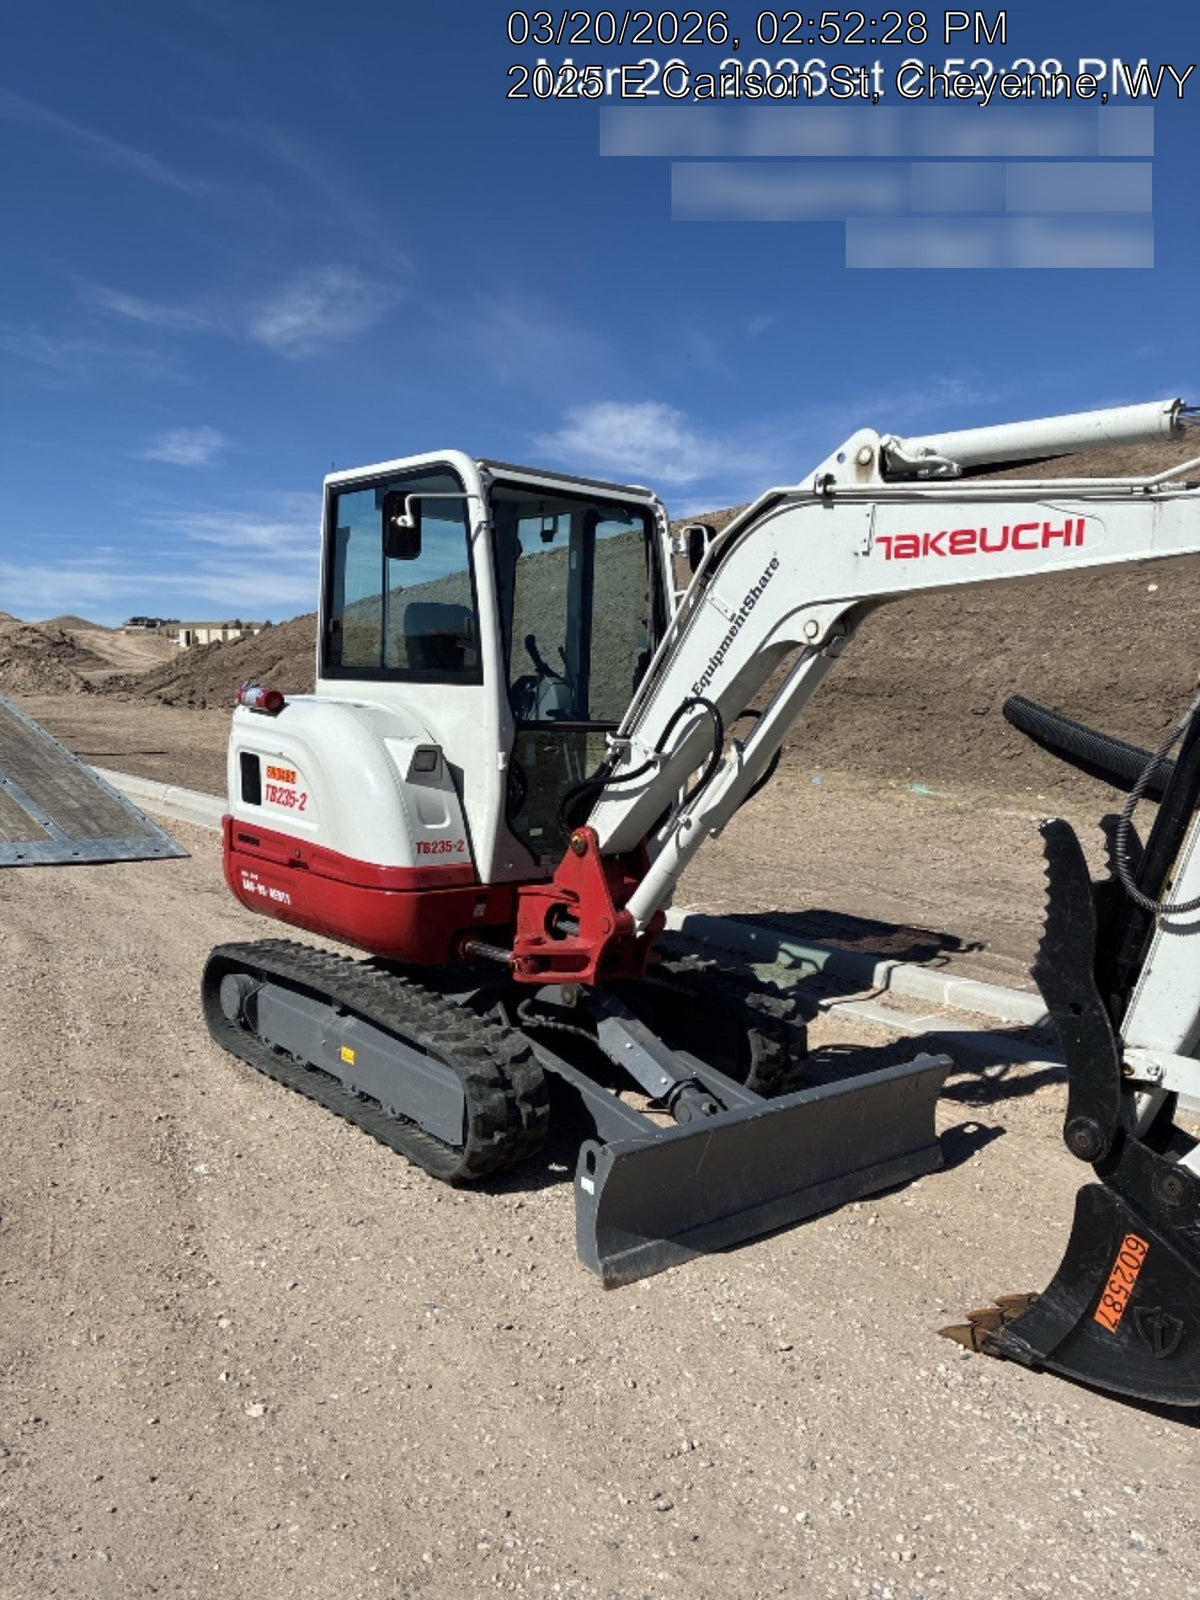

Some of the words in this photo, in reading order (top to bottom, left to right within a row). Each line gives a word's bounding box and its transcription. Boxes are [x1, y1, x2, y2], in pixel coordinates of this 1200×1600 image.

[691, 557, 780, 697] EquipmentShare
[266, 784, 308, 811] TB235-2
[415, 839, 465, 854] TB235-2
[1099, 1237, 1146, 1328] 602587
